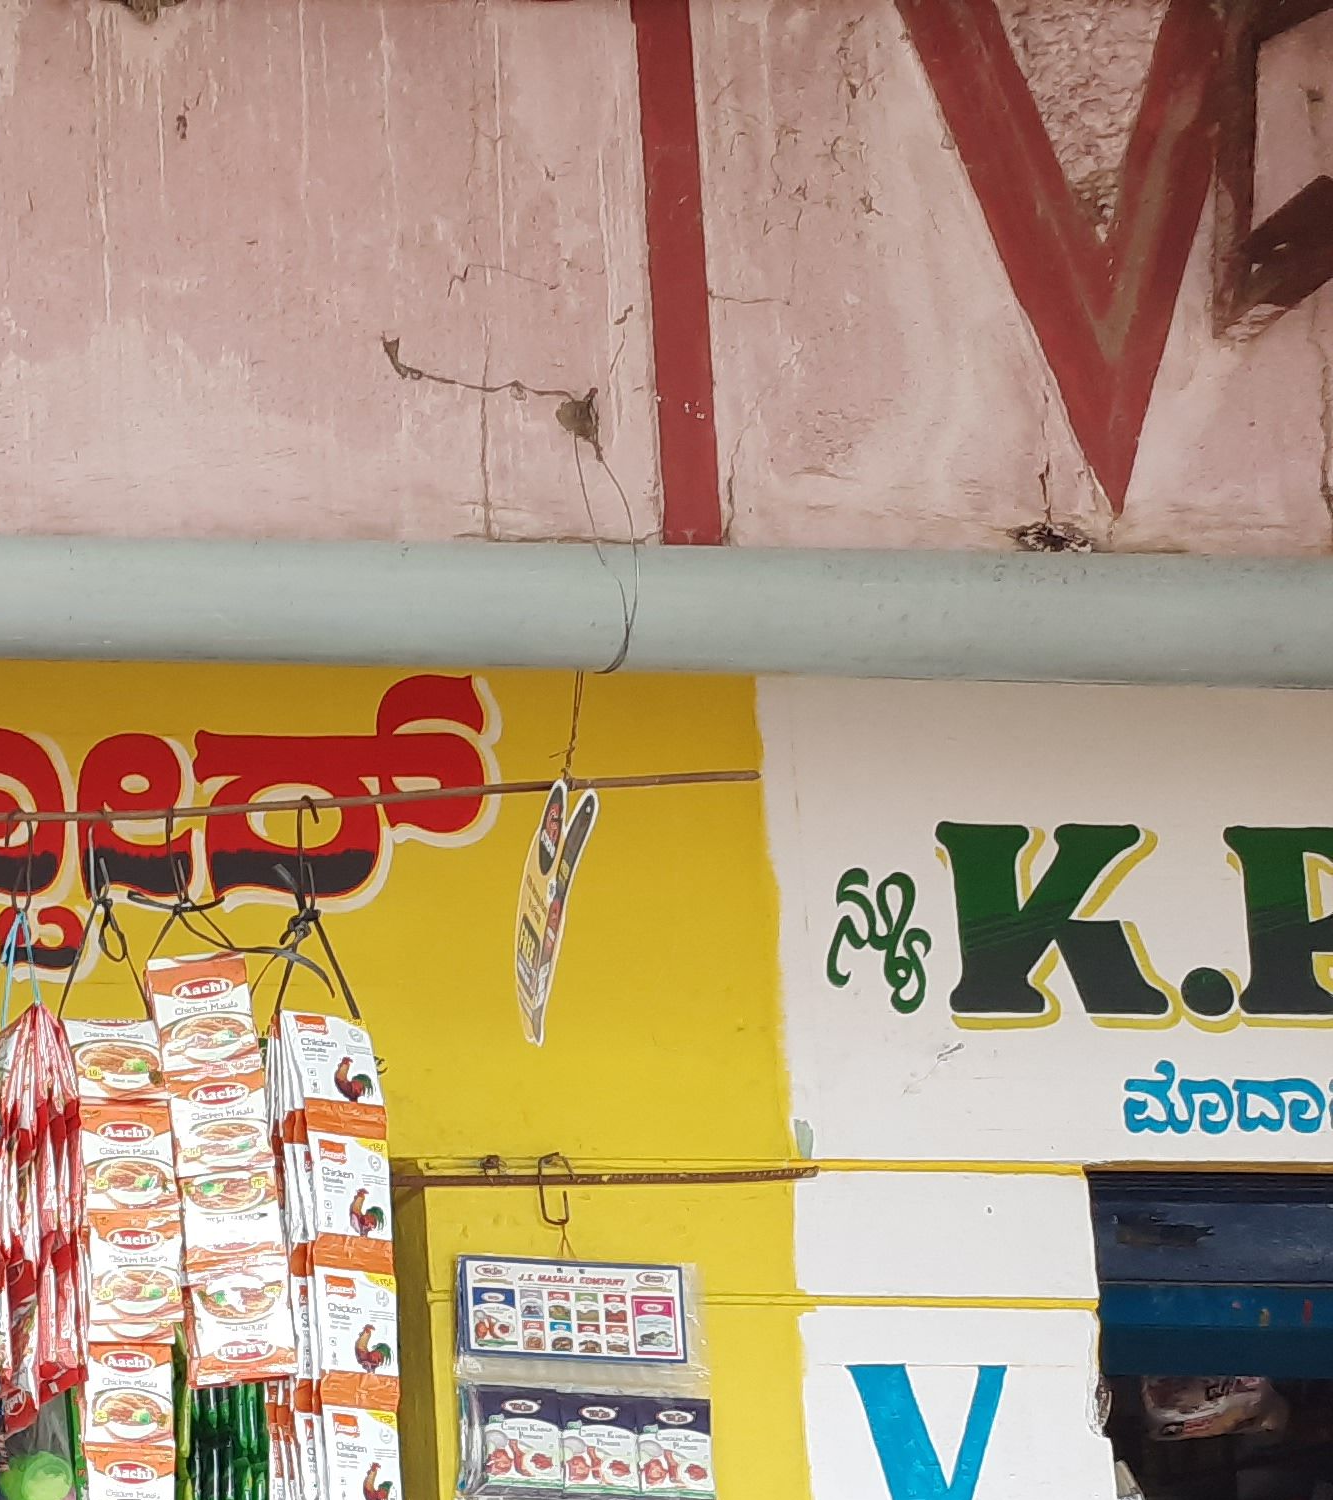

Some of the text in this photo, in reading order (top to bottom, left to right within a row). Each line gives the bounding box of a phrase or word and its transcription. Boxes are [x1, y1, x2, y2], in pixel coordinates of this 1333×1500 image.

[179, 980, 226, 997] Aachi
[301, 1038, 337, 1048] Chicken
[196, 1085, 245, 1101] Aachi
[103, 1125, 150, 1140] Aachi
[322, 1167, 354, 1179] Chicken
[112, 1231, 157, 1246] Aachi
[107, 1355, 151, 1369] Aachi
[110, 1463, 152, 1481] Aachi
